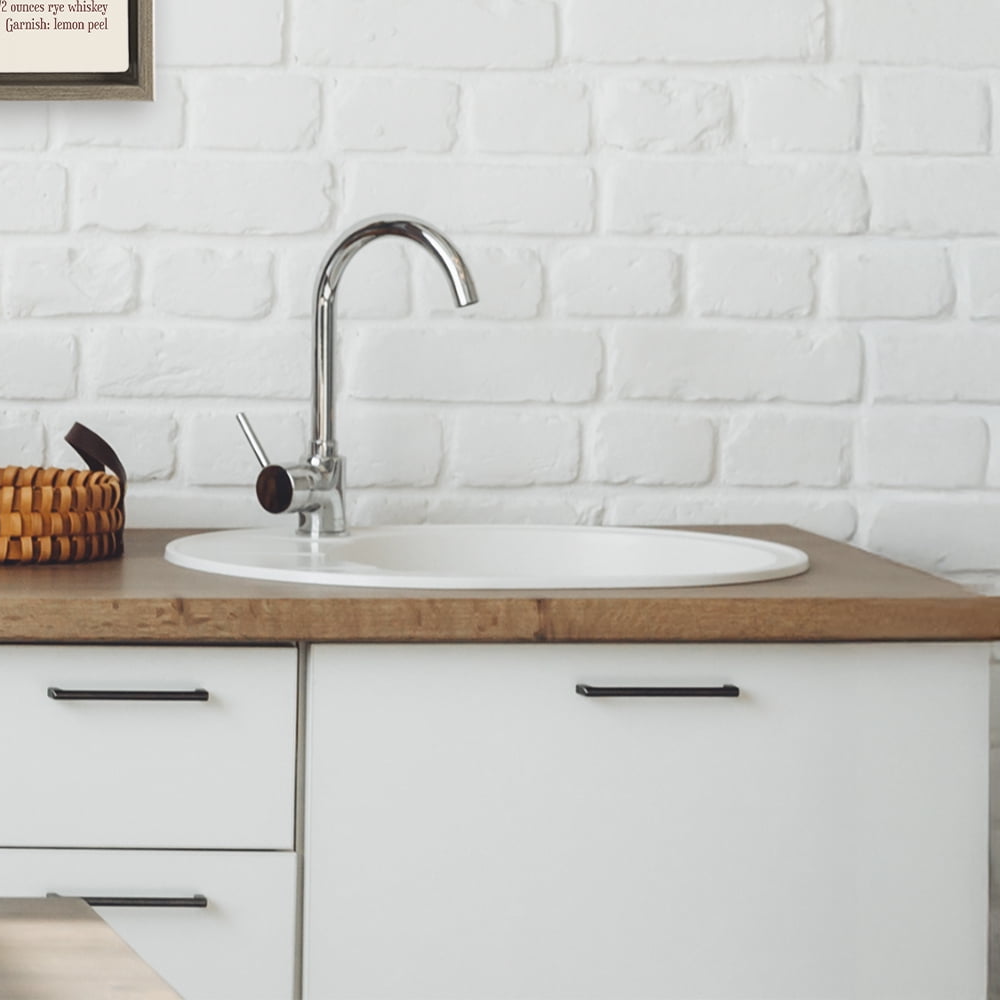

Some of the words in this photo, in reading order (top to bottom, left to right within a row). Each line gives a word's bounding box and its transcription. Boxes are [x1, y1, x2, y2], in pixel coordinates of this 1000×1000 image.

[10, 3, 45, 14] ounces
[47, 3, 65, 16] rye
[67, 0, 109, 16] whiskey
[5, 17, 50, 33] Garnish:
[53, 17, 85, 31] lemon
[87, 16, 109, 34] peel
